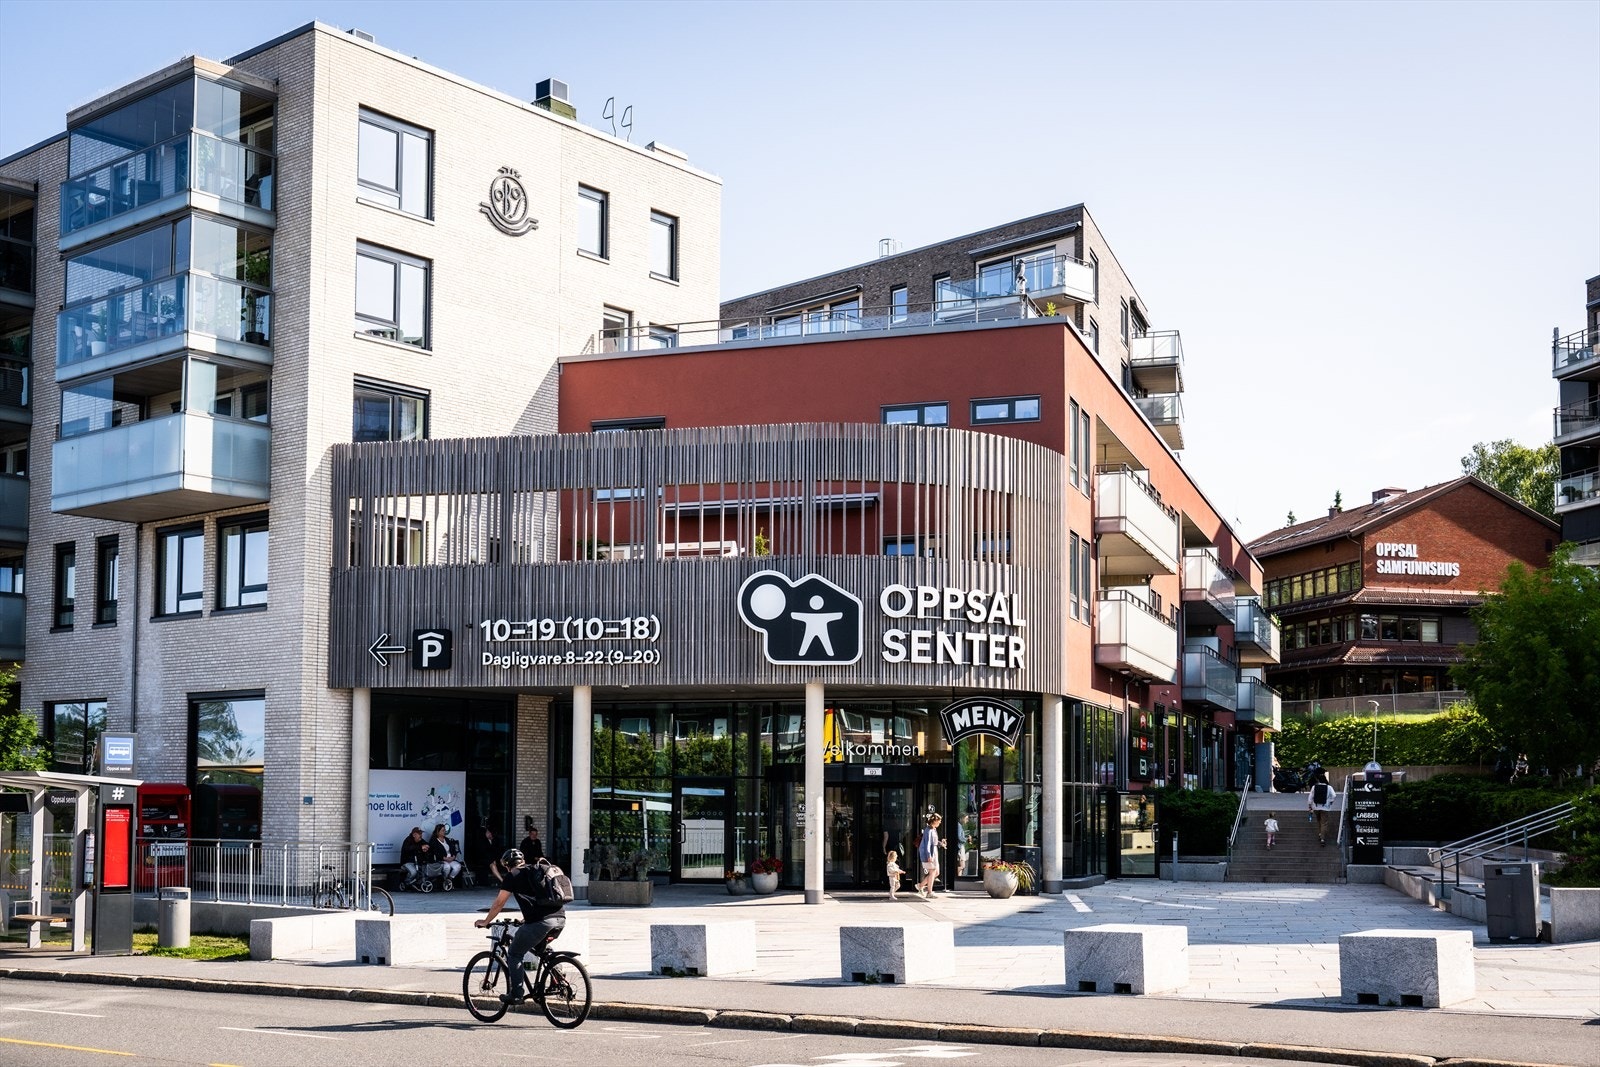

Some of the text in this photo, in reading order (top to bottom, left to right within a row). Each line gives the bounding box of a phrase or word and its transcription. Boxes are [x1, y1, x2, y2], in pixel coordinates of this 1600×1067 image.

[1376, 542, 1418, 558] OPPSAL
[1376, 559, 1460, 576] SAMFUNNSHUS
[880, 584, 1026, 627] OPPSAL
[422, 639, 442, 667] P
[882, 628, 1026, 669] SENTER
[482, 652, 562, 669] Dagligvare
[951, 706, 1016, 732] MENY
[51, 795, 66, 804] Oppsal
[368, 800, 413, 811] noe lokalt
